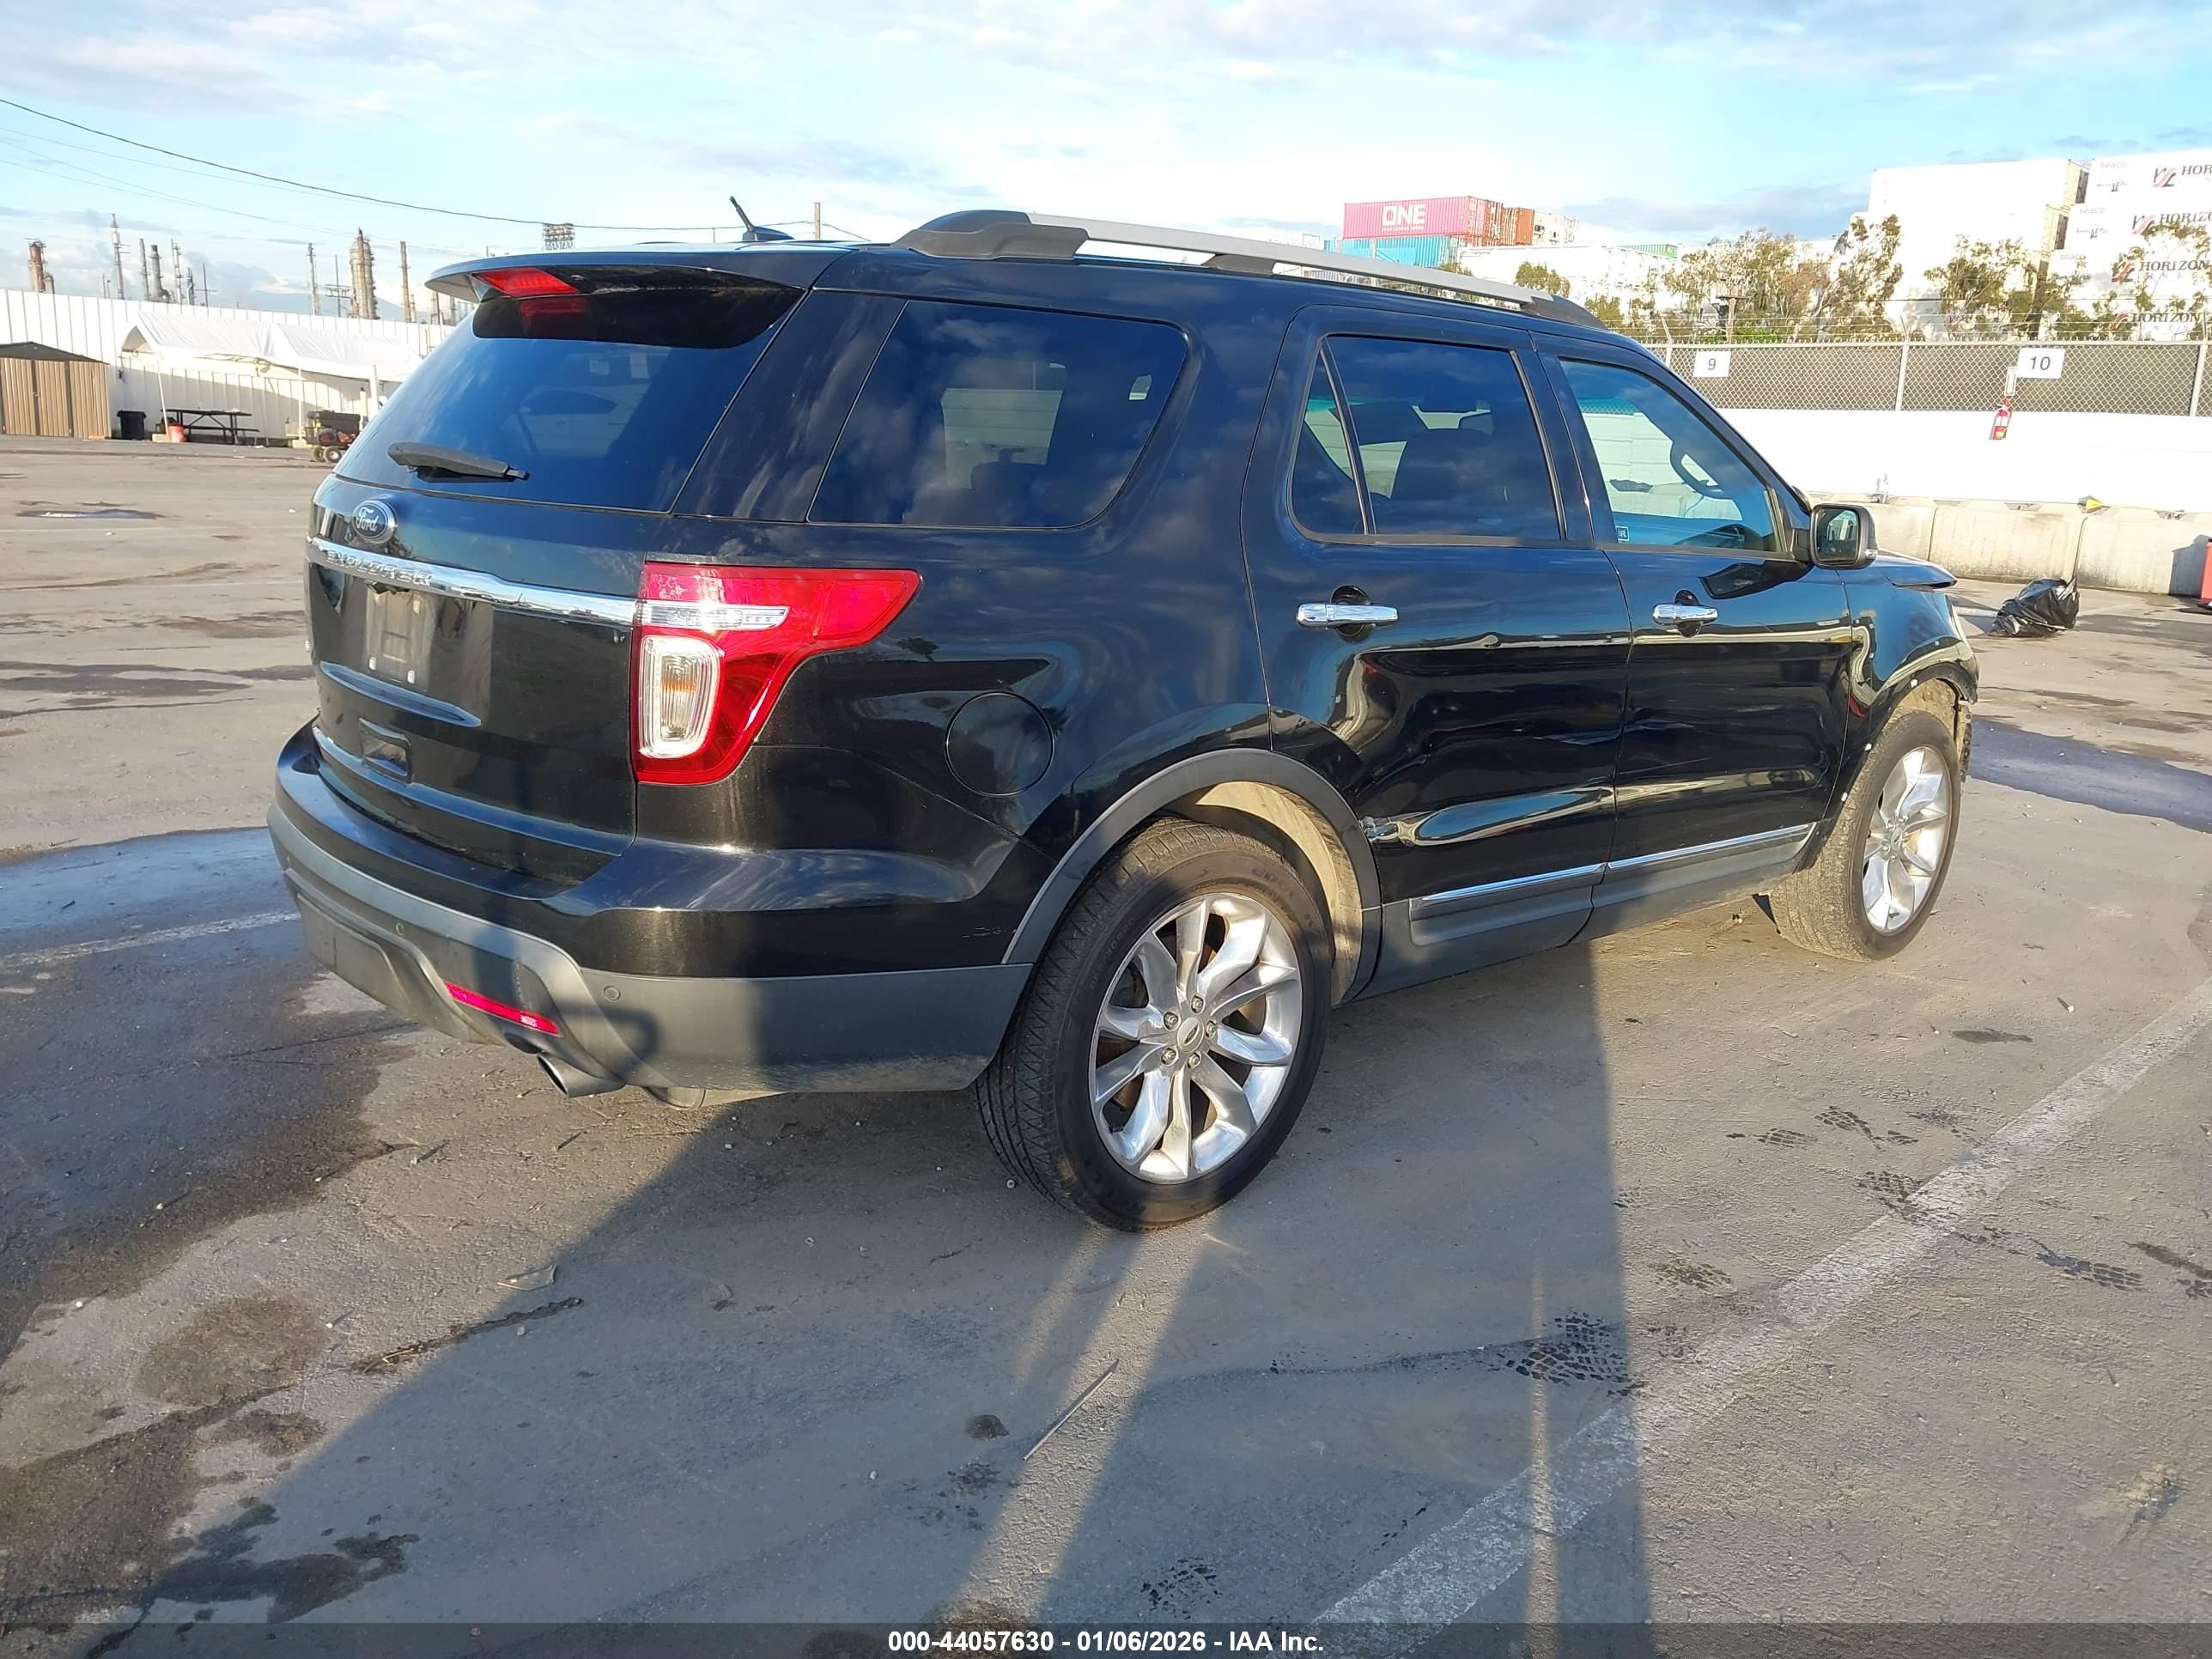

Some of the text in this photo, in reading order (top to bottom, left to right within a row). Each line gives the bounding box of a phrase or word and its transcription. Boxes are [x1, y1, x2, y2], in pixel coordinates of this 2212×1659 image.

[1382, 204, 1425, 226] ONE
[2139, 260, 2210, 271] HORIZON
[2130, 312, 2201, 323] HORIZON
[1707, 357, 1717, 371] 9
[2030, 356, 2051, 371] 10
[356, 507, 379, 532] Ford
[325, 550, 433, 586] EXPLORER
